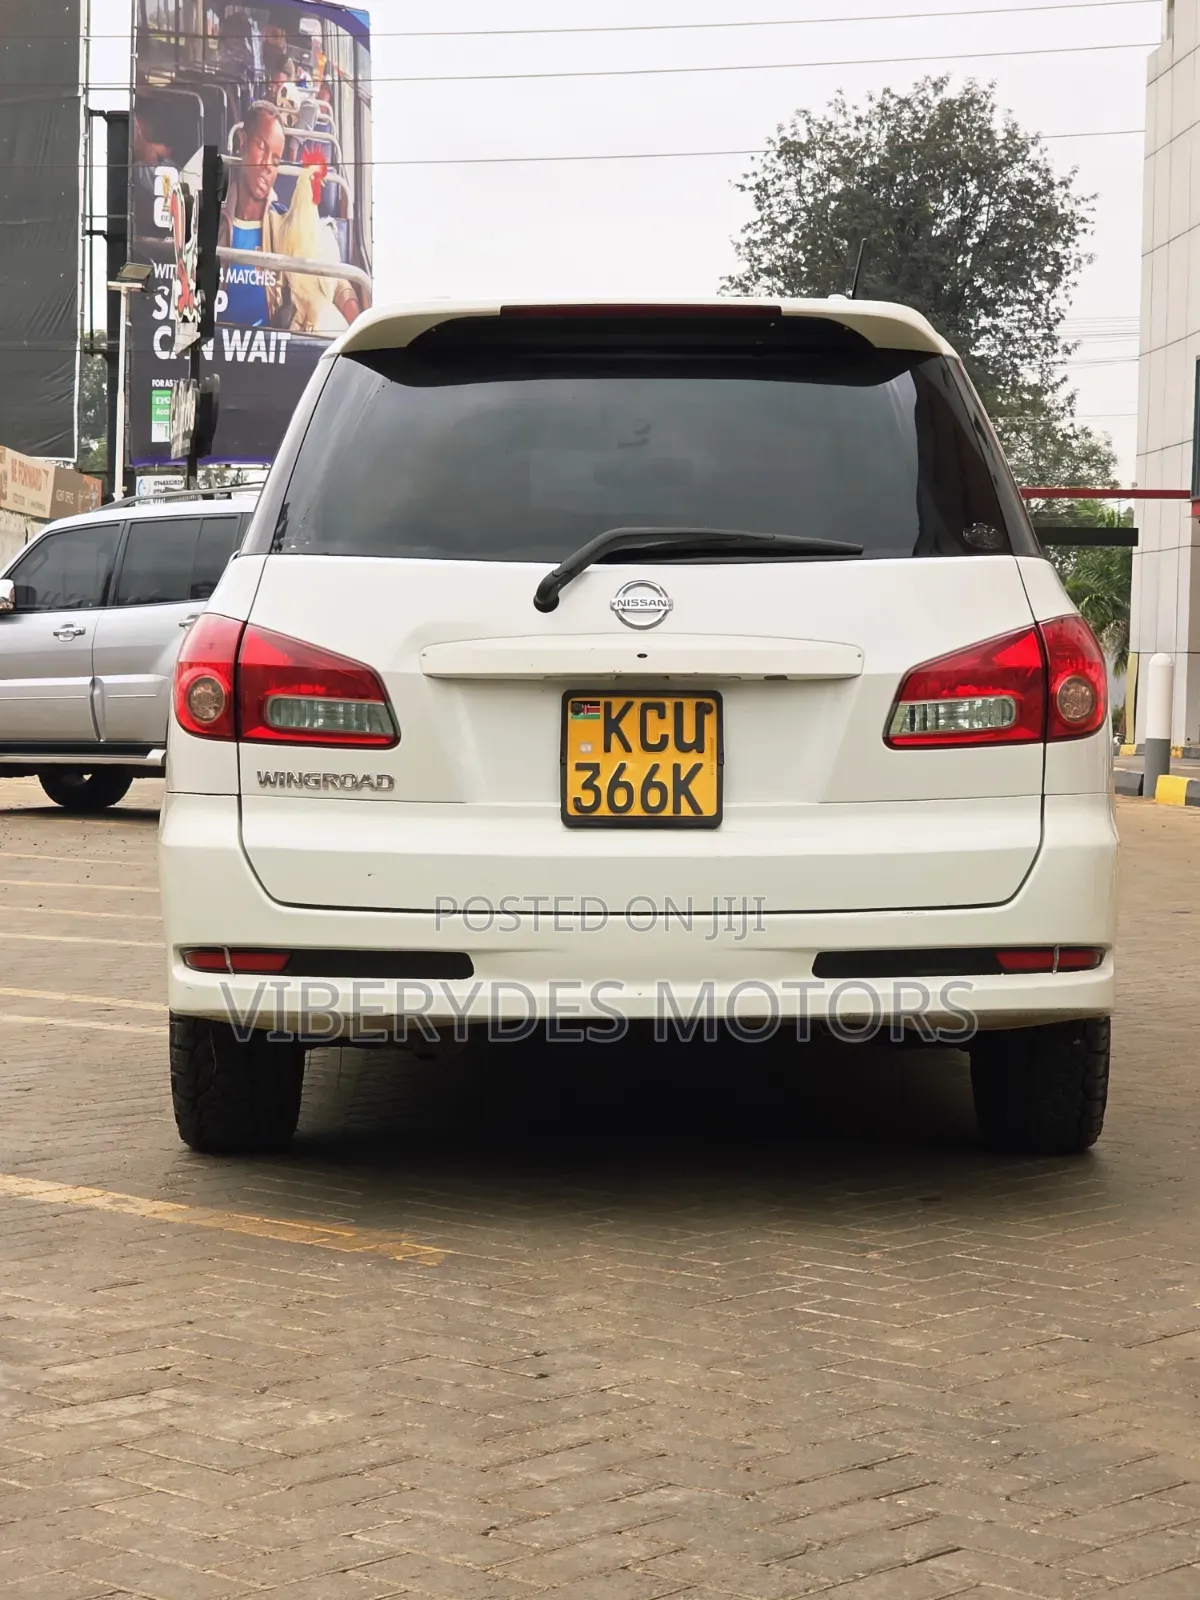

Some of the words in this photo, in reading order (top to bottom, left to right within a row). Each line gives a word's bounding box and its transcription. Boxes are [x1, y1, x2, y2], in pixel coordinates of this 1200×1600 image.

[226, 268, 276, 287] MATCHES
[222, 328, 291, 364] WAIT
[617, 598, 668, 608] NISSAN
[603, 701, 706, 753] KCU
[257, 770, 395, 791] WINGROAD
[573, 762, 704, 815] 366K
